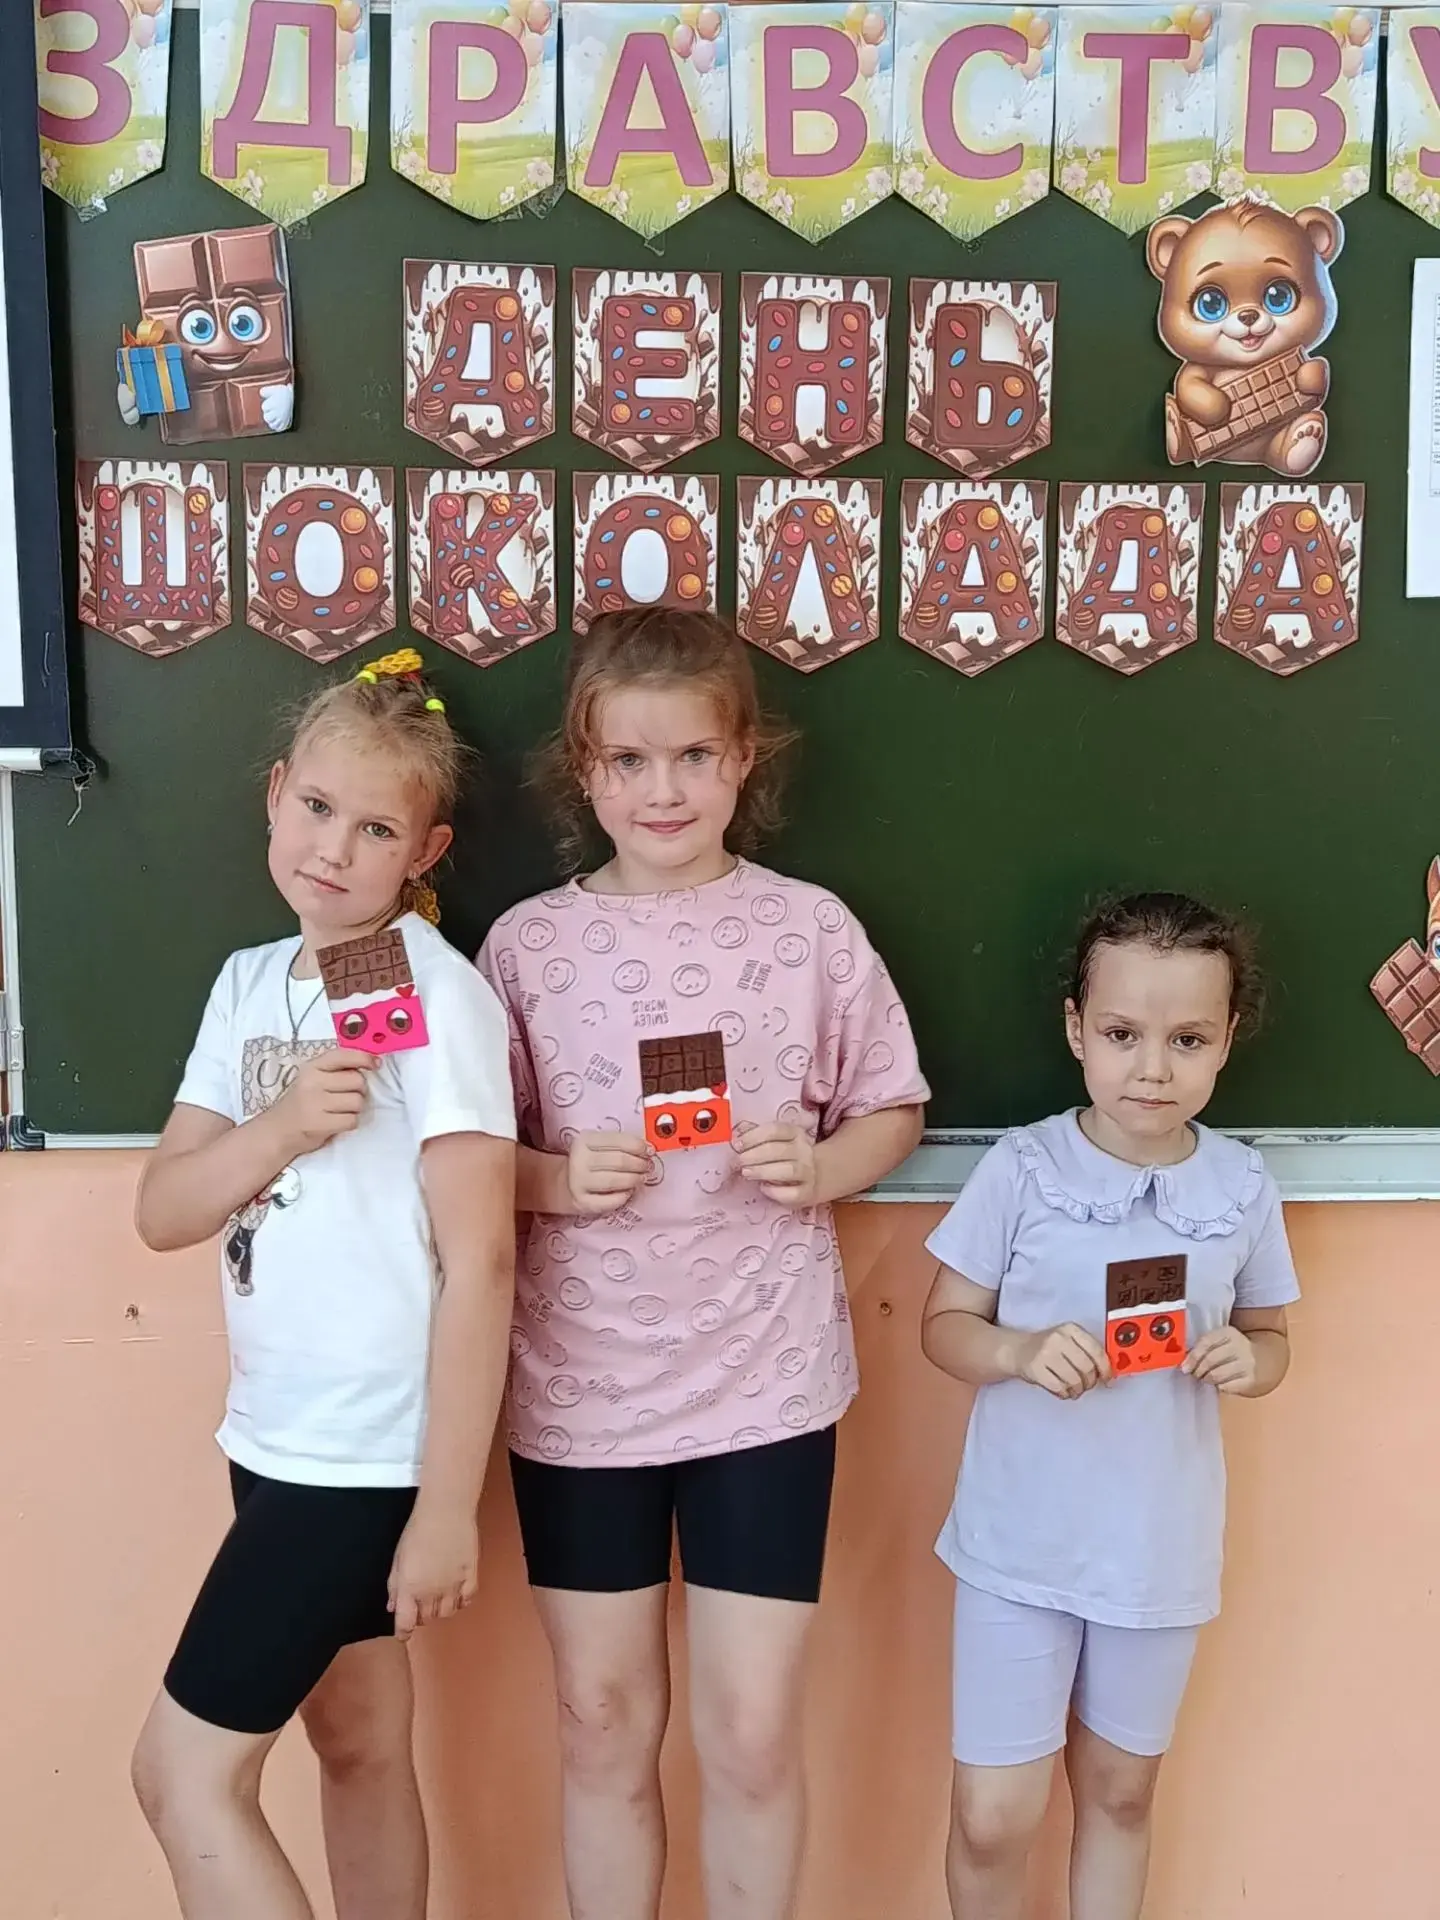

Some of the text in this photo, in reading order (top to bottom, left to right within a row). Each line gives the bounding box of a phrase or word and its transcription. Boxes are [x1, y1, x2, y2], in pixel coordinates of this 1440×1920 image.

[415, 286, 1038, 448] ДЕНЬ
[95, 483, 1355, 643] ШОКОЛАДА
[632, 1011, 670, 1027] SMILEY
